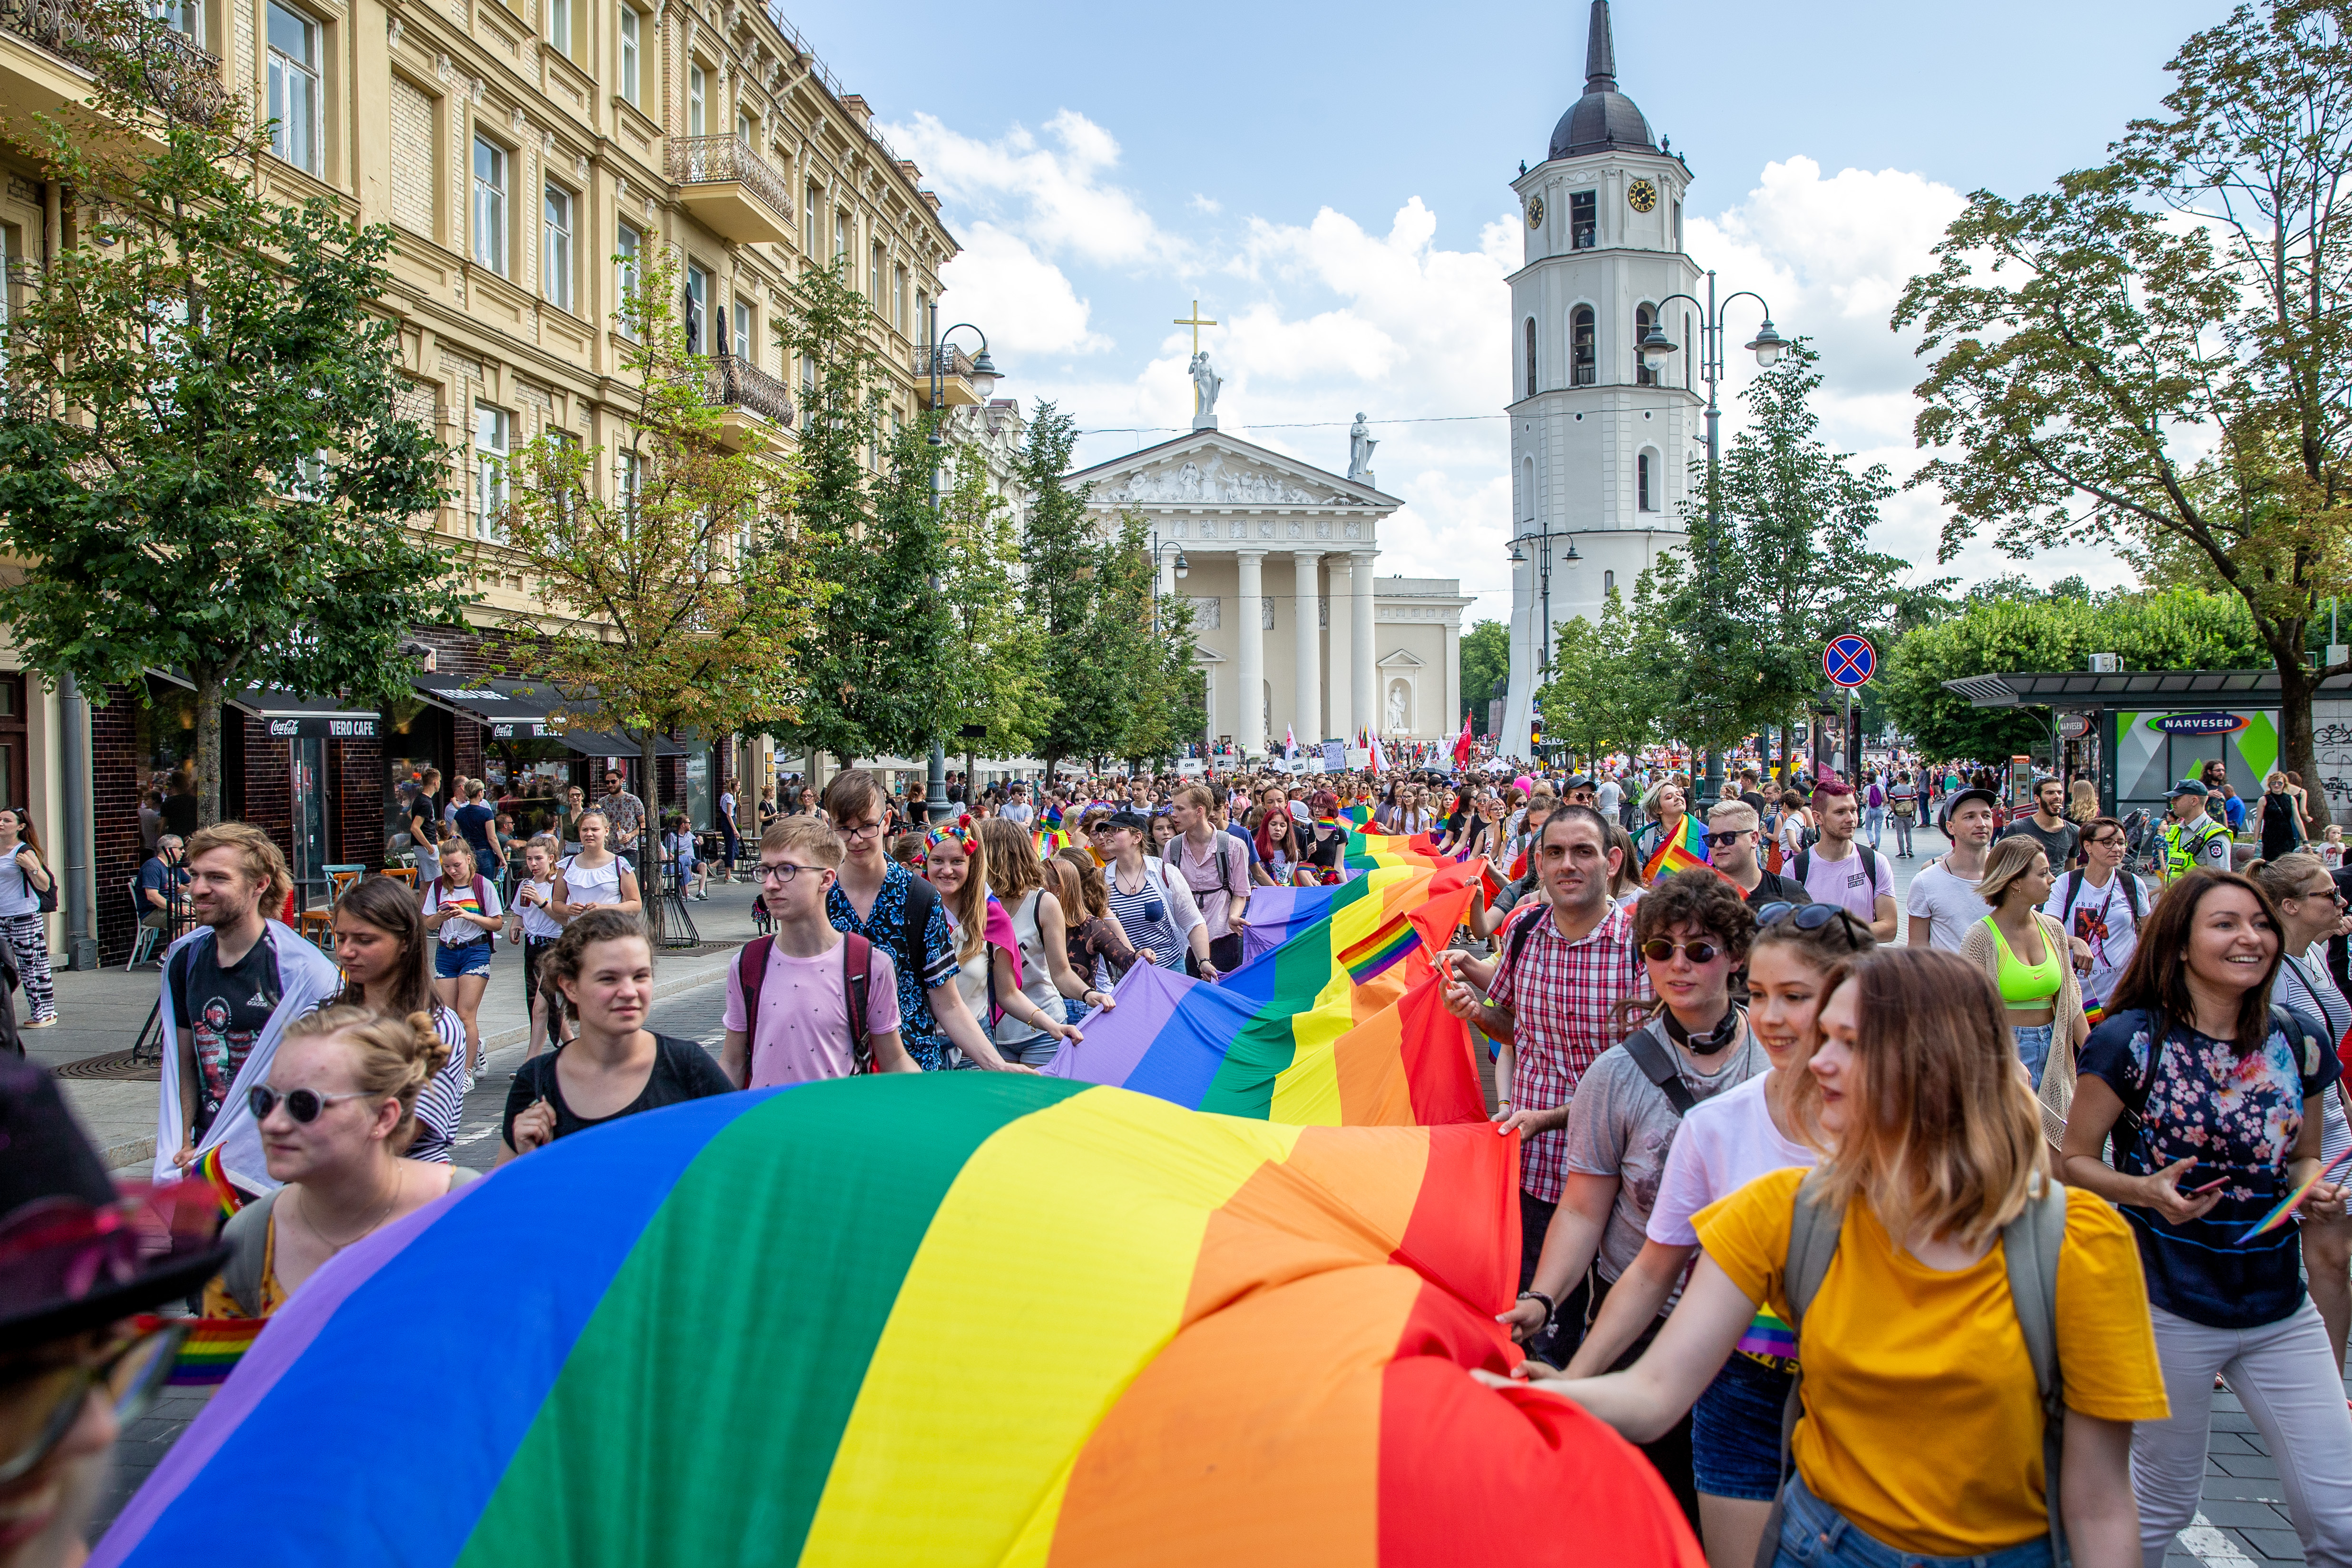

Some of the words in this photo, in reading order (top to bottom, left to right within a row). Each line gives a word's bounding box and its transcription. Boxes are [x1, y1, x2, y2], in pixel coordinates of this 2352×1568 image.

[330, 720, 353, 735] VERO
[353, 721, 374, 735] CAFE
[2060, 721, 2083, 730] NARVESEN
[2165, 719, 2233, 728] NARVESEN
[206, 1009, 227, 1022] NFV
